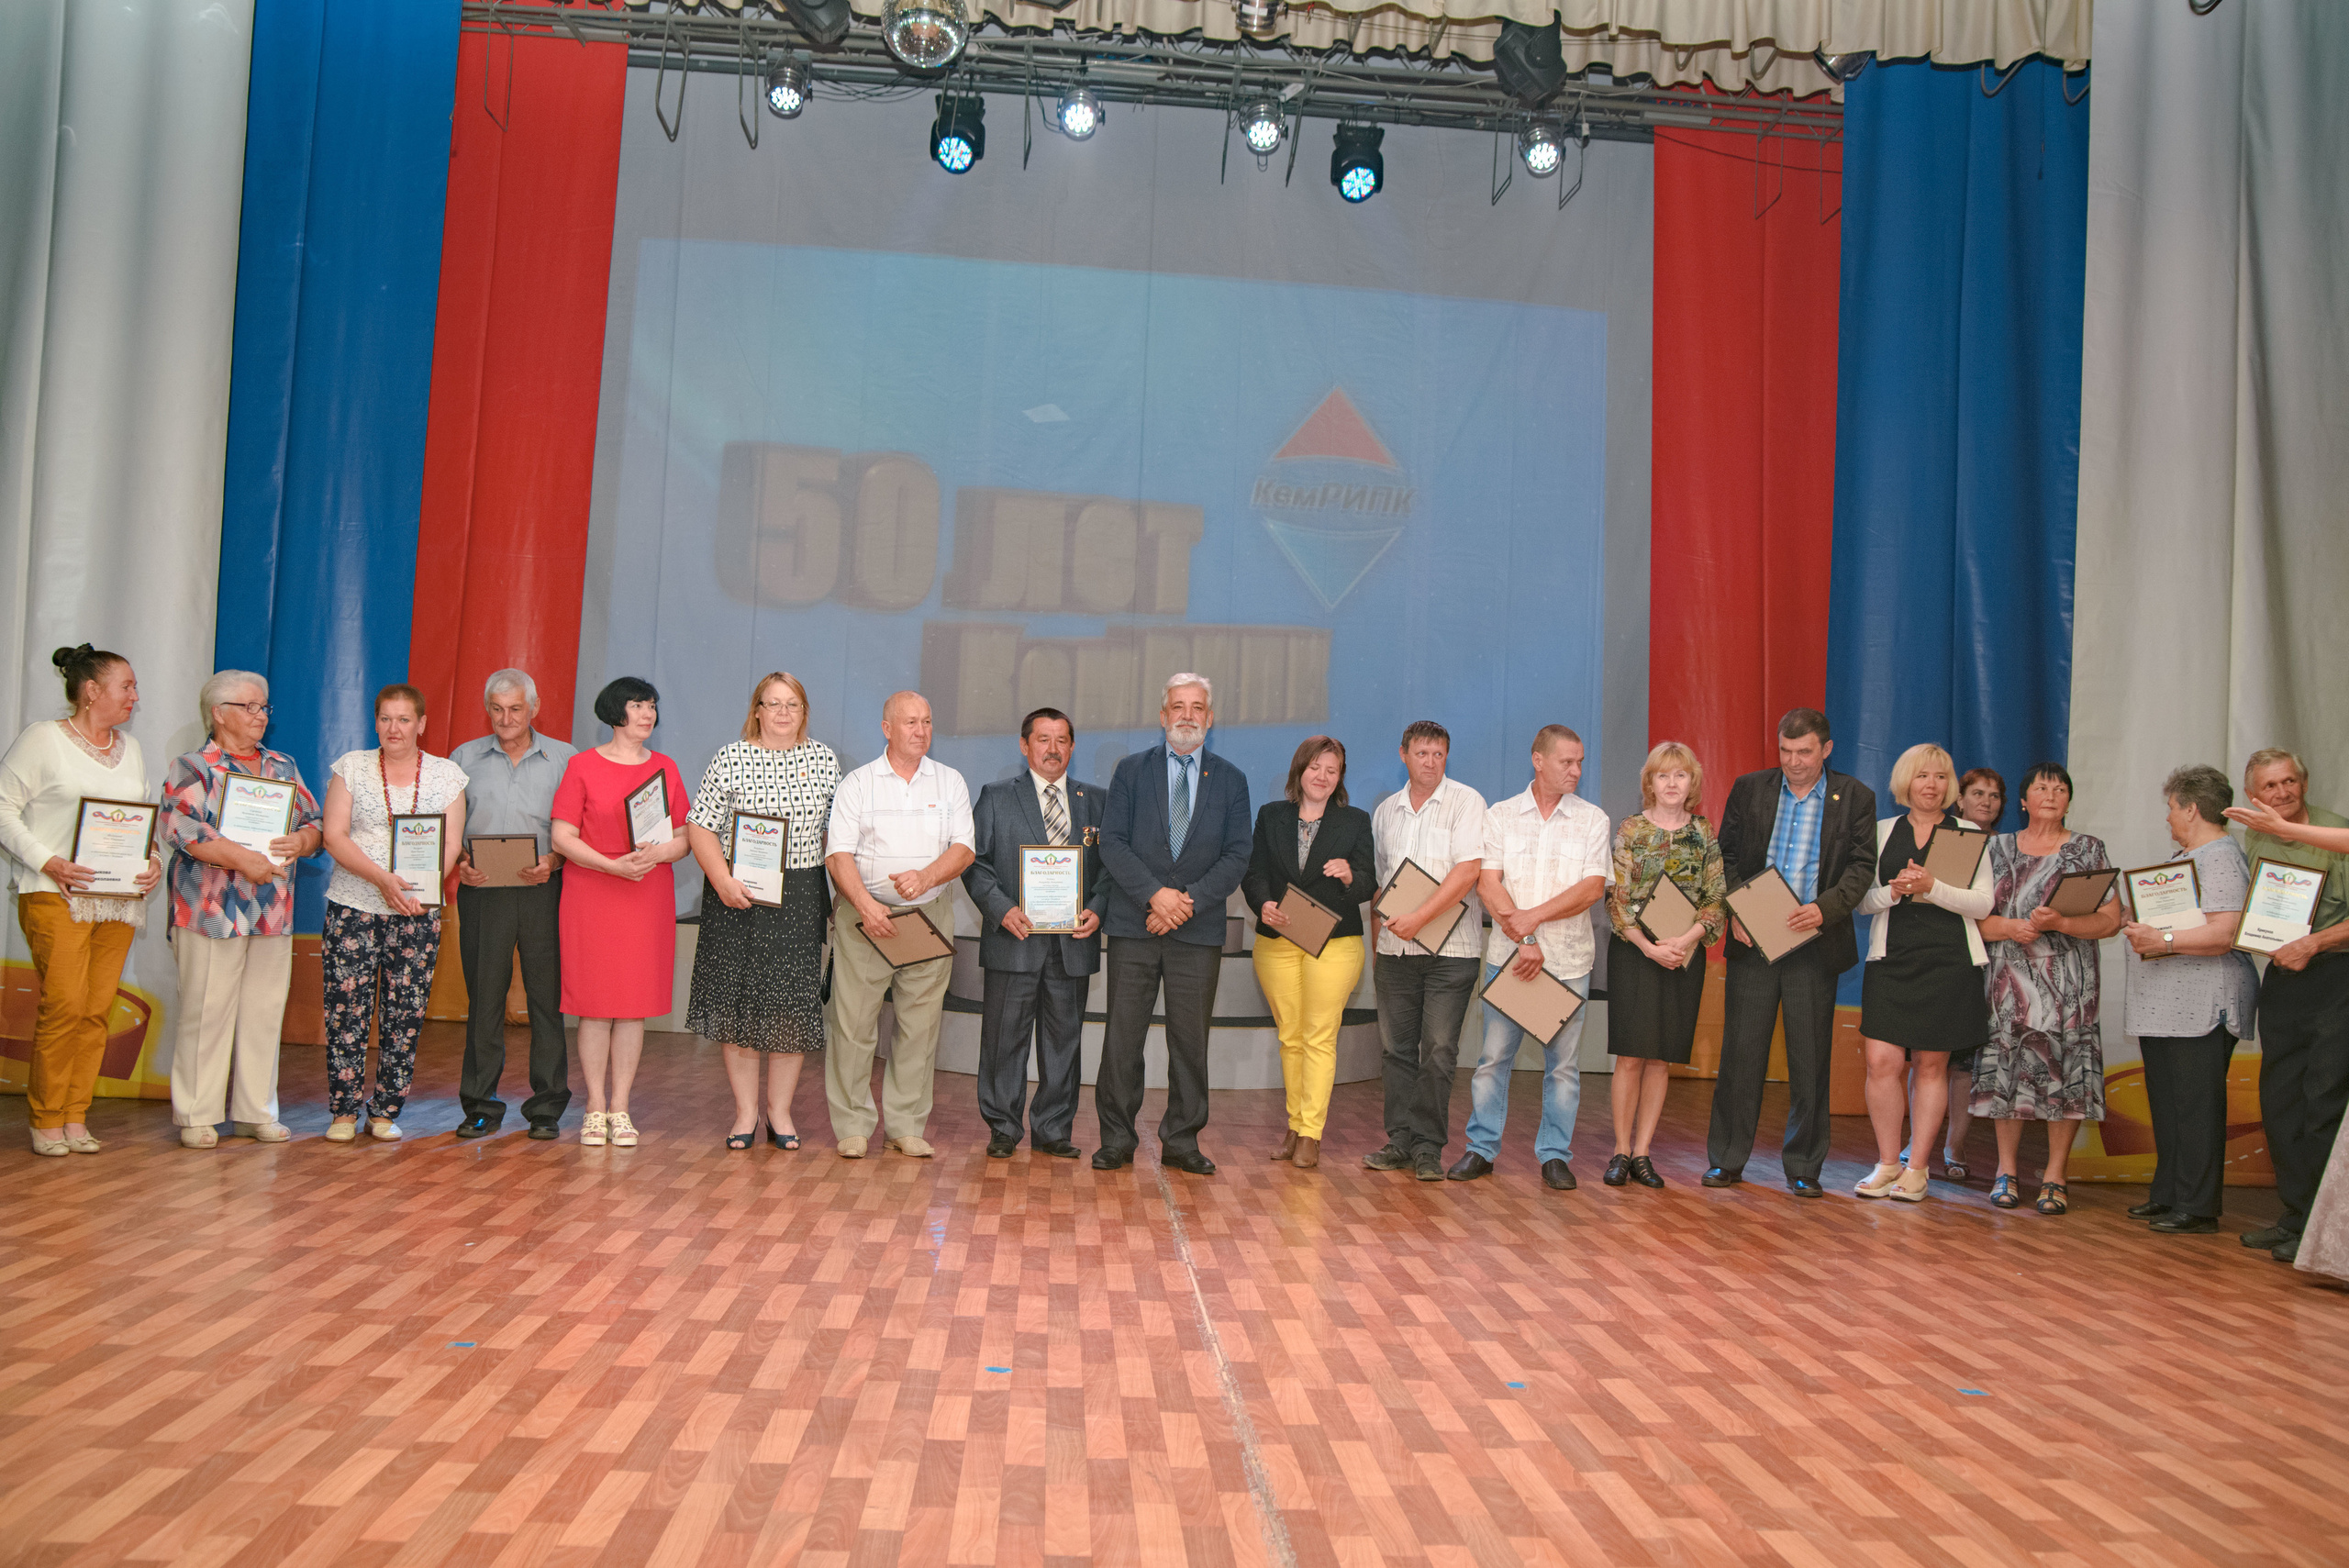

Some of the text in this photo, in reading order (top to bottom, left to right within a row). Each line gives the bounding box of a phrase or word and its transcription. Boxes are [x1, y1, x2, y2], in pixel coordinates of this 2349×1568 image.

[1252, 474, 1416, 516] КемРИПК
[715, 441, 941, 614] 50
[742, 838, 777, 847] БЛАГОДАРНОСТЬ
[2141, 887, 2188, 898] БЛАГОДАРНОСТЬ
